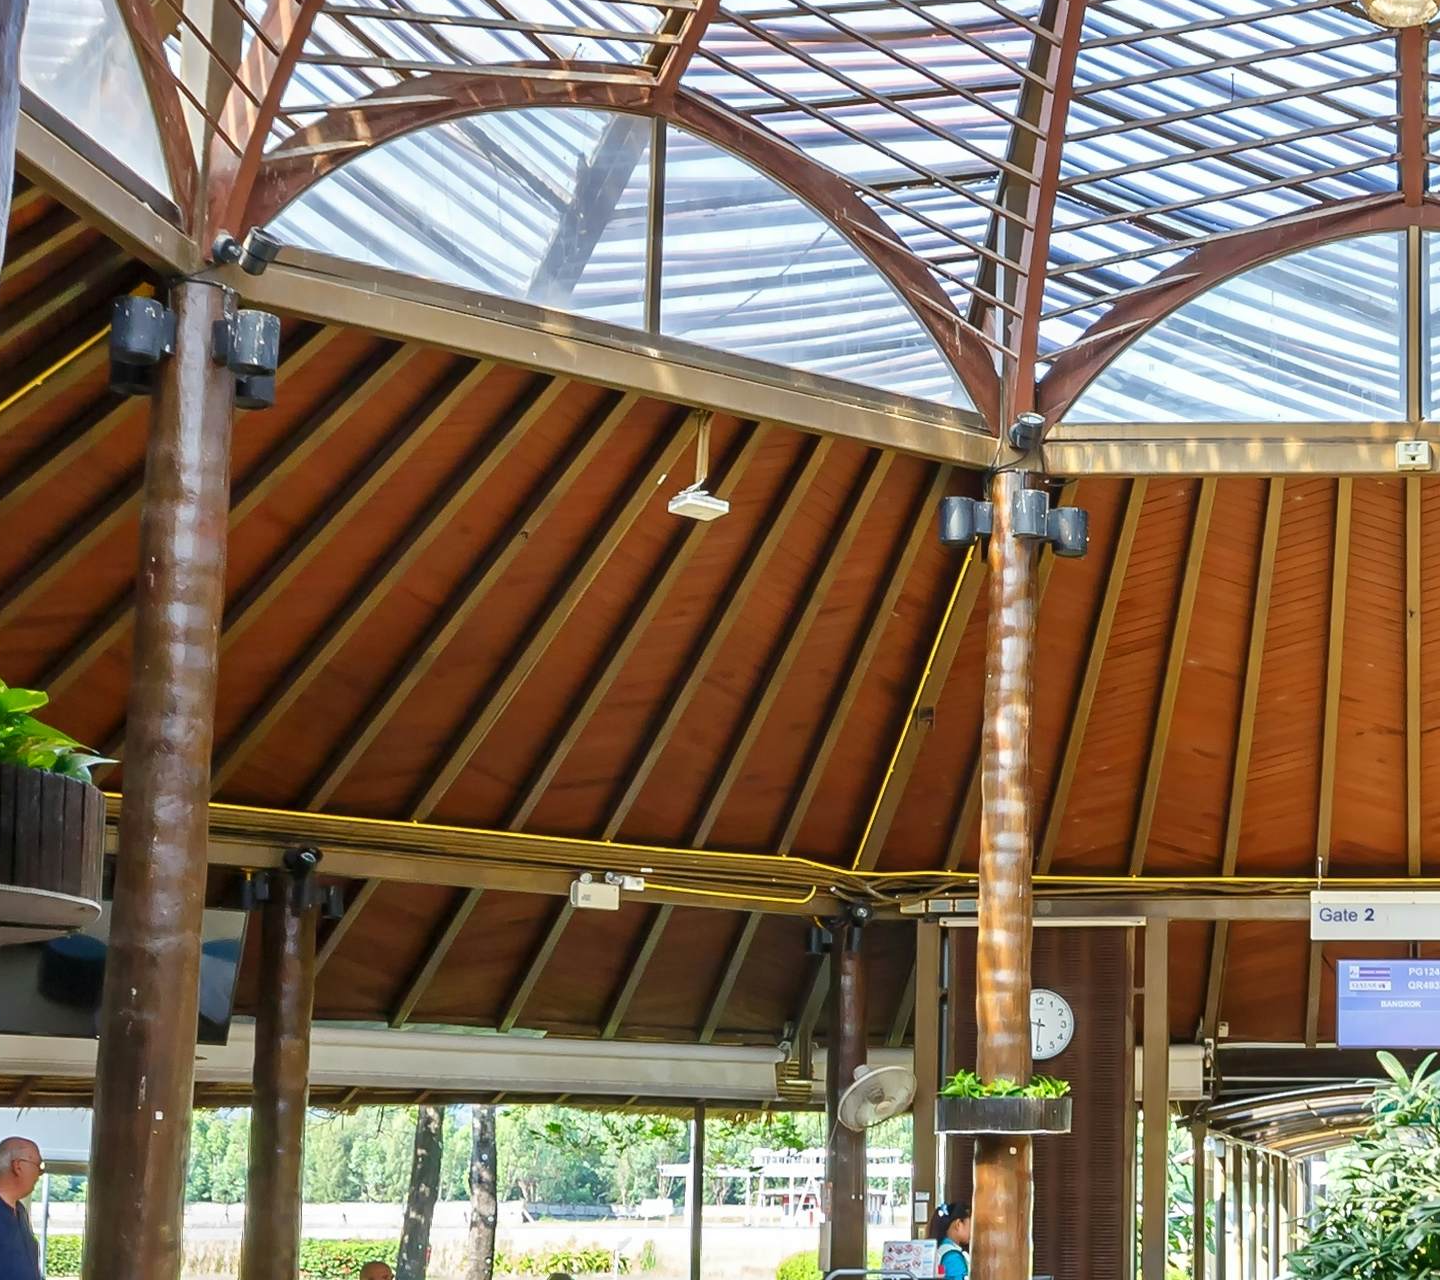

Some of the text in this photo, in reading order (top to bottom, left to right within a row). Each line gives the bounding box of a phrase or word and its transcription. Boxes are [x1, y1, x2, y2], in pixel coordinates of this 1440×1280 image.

[1319, 907, 1375, 922] Gate 2
[1380, 1000, 1422, 1008] BANGKOK
[1057, 1008, 1063, 1016] 2
[1060, 1021, 1067, 1029] 3
[1049, 1041, 1055, 1049] 5
